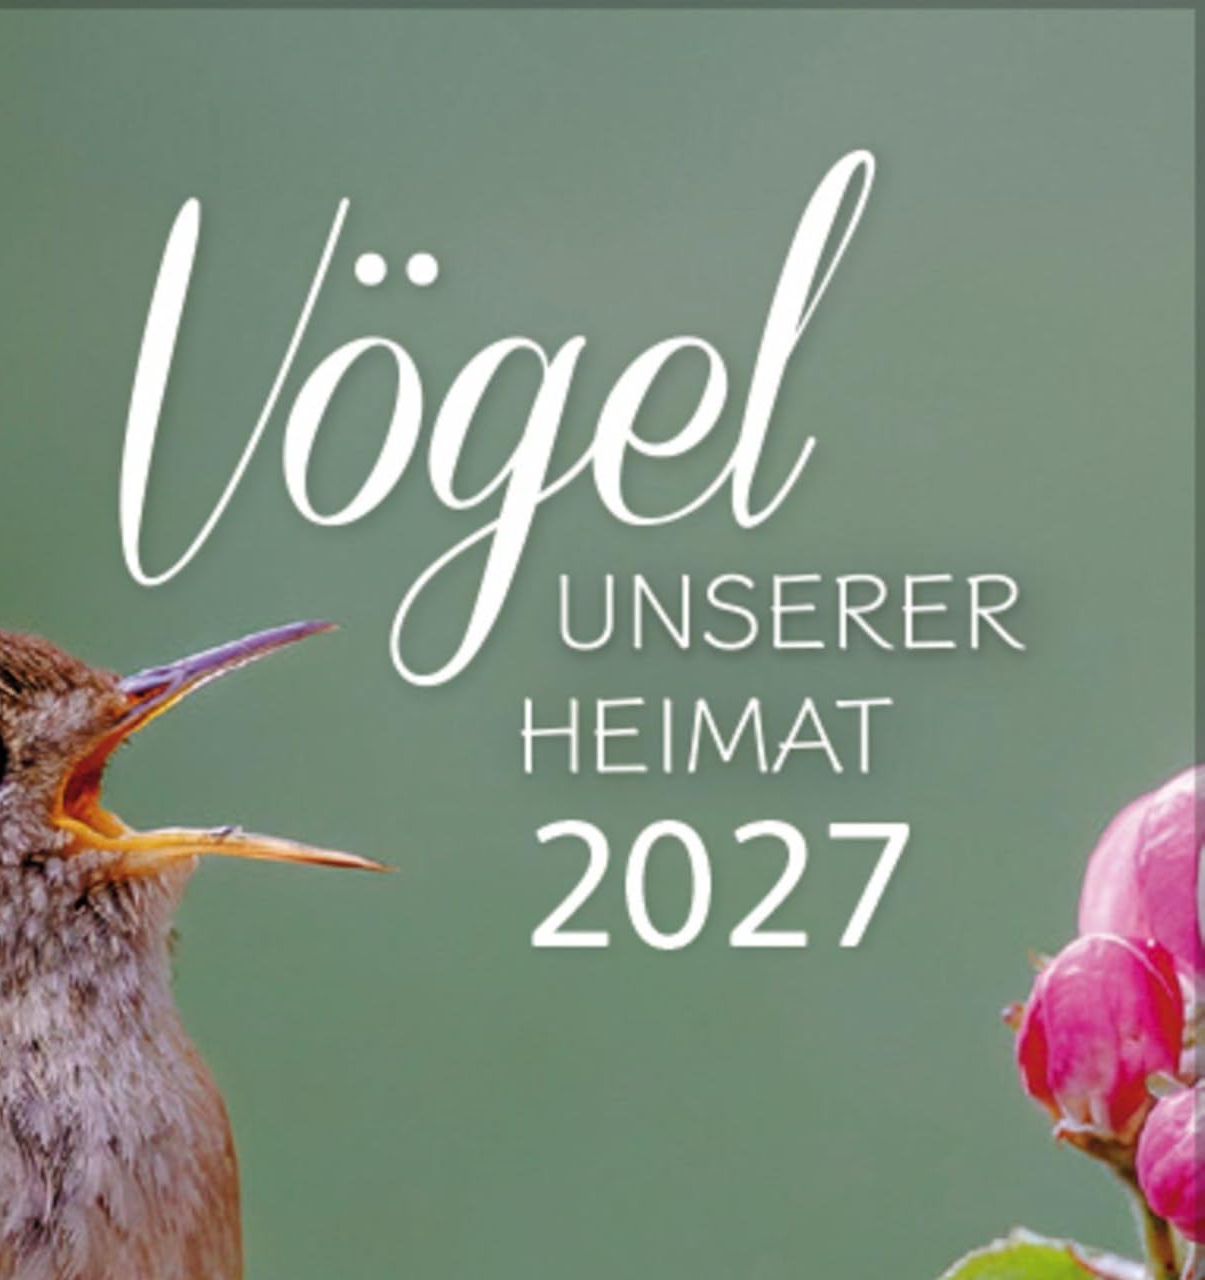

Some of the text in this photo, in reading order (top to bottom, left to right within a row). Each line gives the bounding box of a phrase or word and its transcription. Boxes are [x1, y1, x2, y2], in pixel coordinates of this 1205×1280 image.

[119, 149, 876, 687] Vögel
[559, 573, 1025, 651] UNSERER
[520, 696, 894, 774] HEIMAT
[530, 818, 911, 951] 2027
